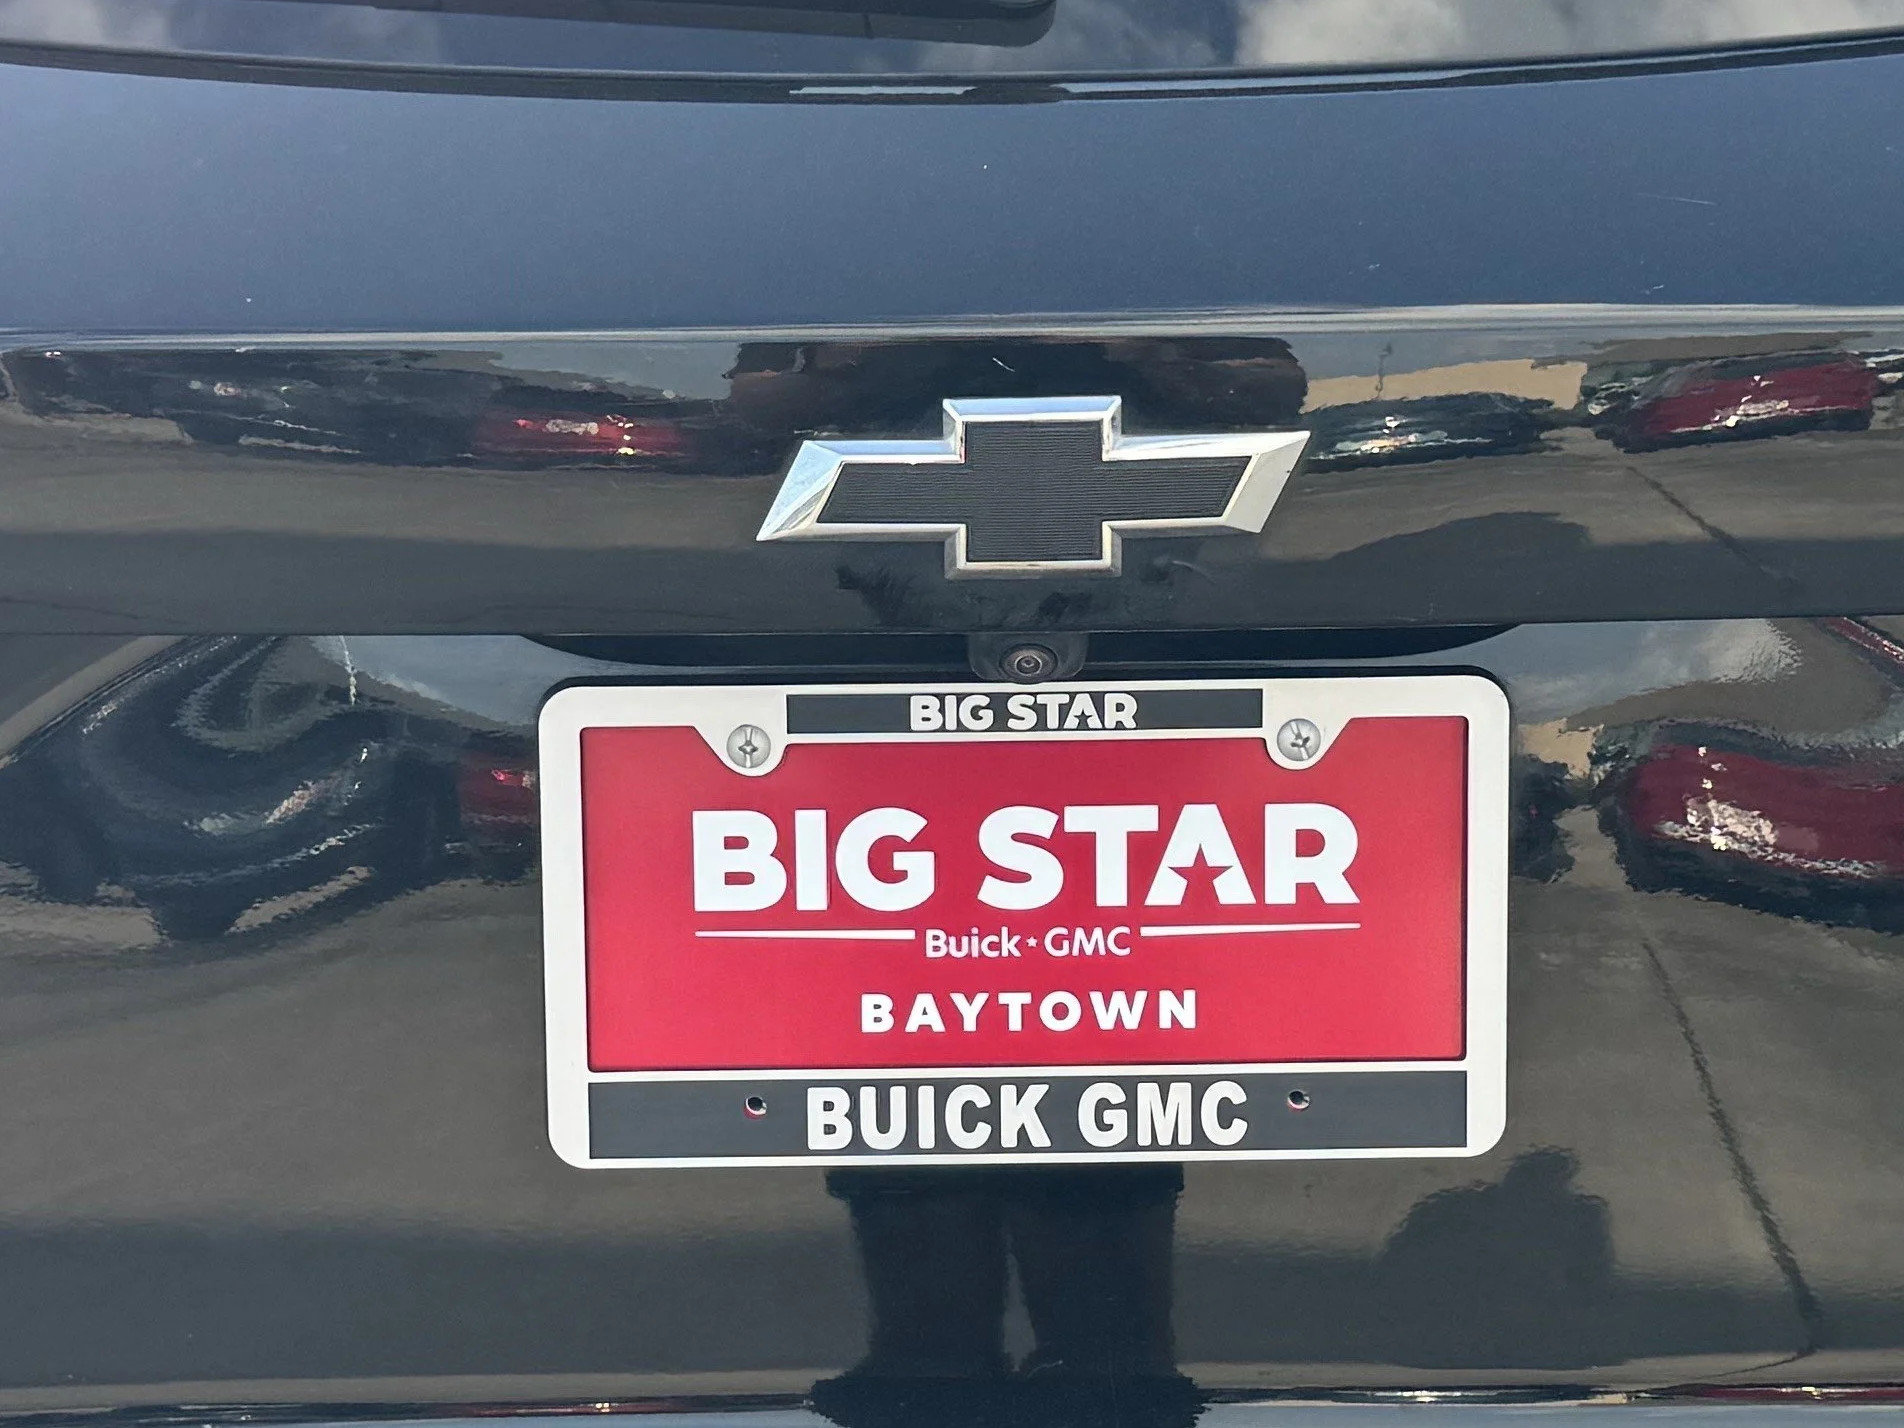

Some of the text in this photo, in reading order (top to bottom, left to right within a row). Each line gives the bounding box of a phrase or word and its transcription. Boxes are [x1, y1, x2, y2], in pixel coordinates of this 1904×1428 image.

[908, 693, 1139, 730] BIG STAR
[692, 803, 1361, 912] BIG STAR
[925, 925, 1131, 959] Buick GMC
[861, 989, 1197, 1033] BAYTOWN
[806, 1081, 1249, 1151] BUICK GMC
